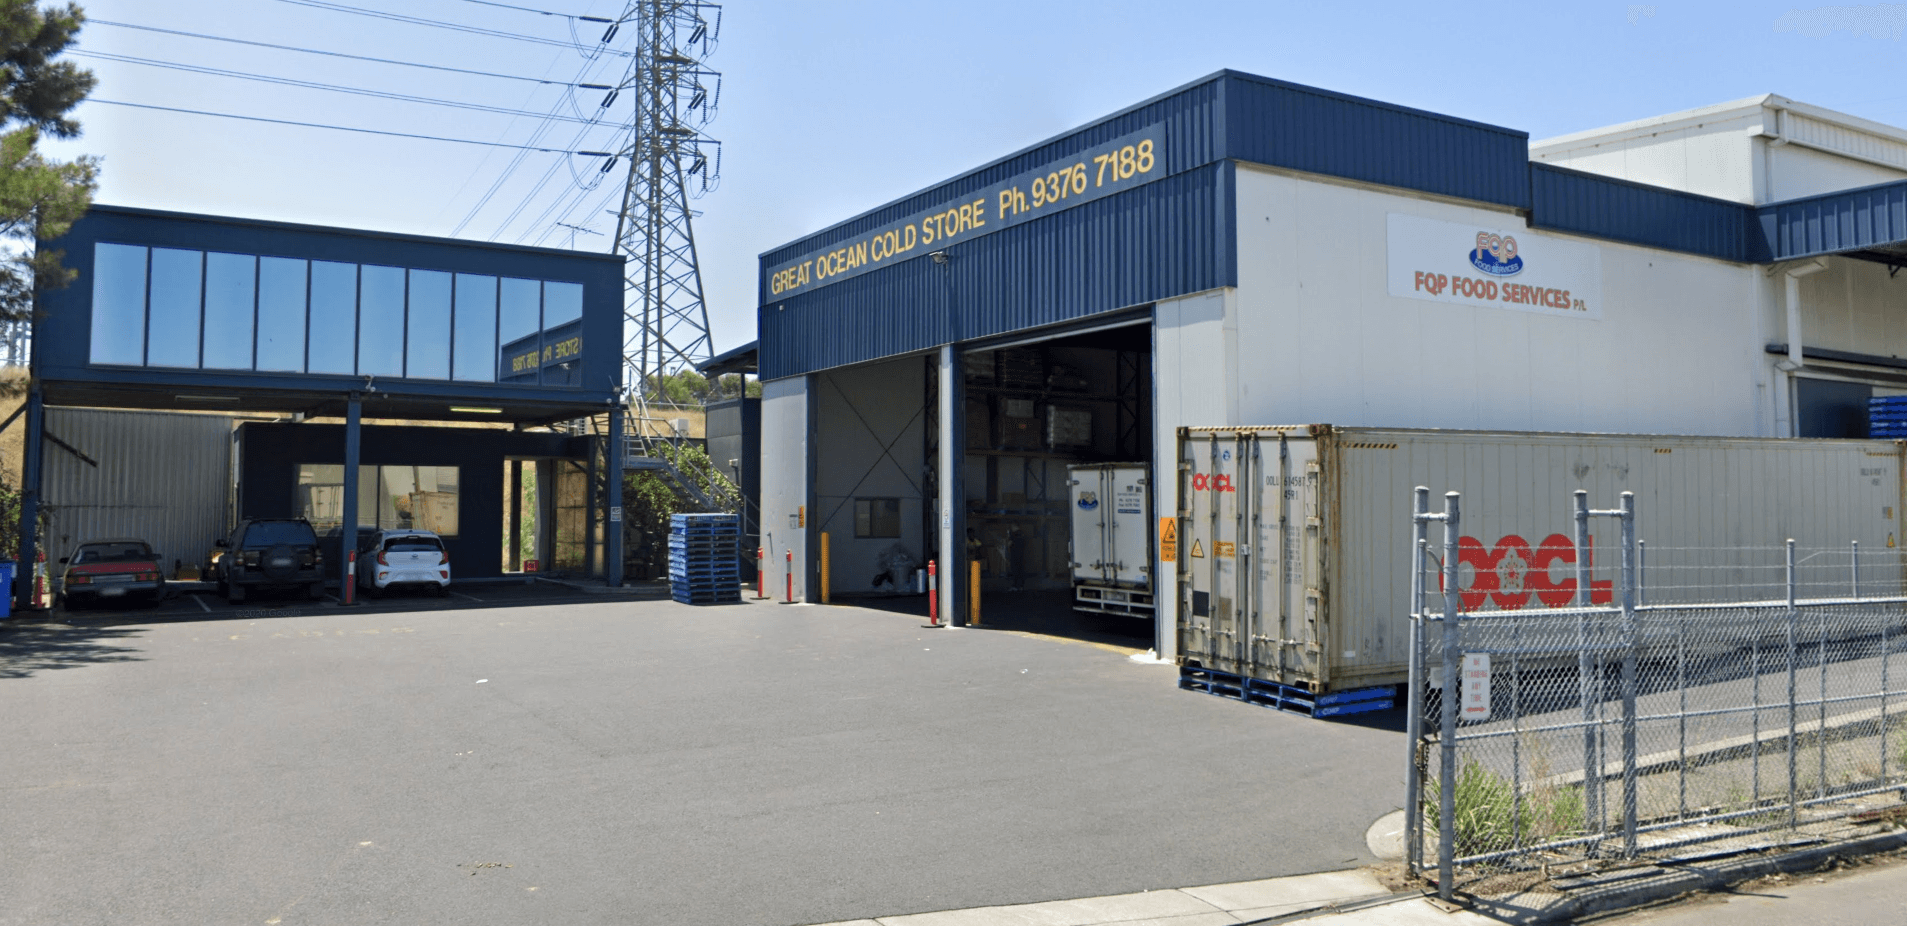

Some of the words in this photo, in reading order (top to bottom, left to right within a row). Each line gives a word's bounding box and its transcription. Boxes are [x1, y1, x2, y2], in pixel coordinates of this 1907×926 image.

[771, 260, 812, 296] GREAT
[816, 243, 868, 281] OCEAN
[871, 223, 917, 263] COLD
[922, 198, 986, 246] STORE
[1093, 138, 1155, 188] 7188
[1415, 271, 1448, 296] FQP
[1452, 276, 1498, 300] FOOD
[1502, 283, 1571, 310] SERVICES
[1193, 473, 1235, 492] OOCL
